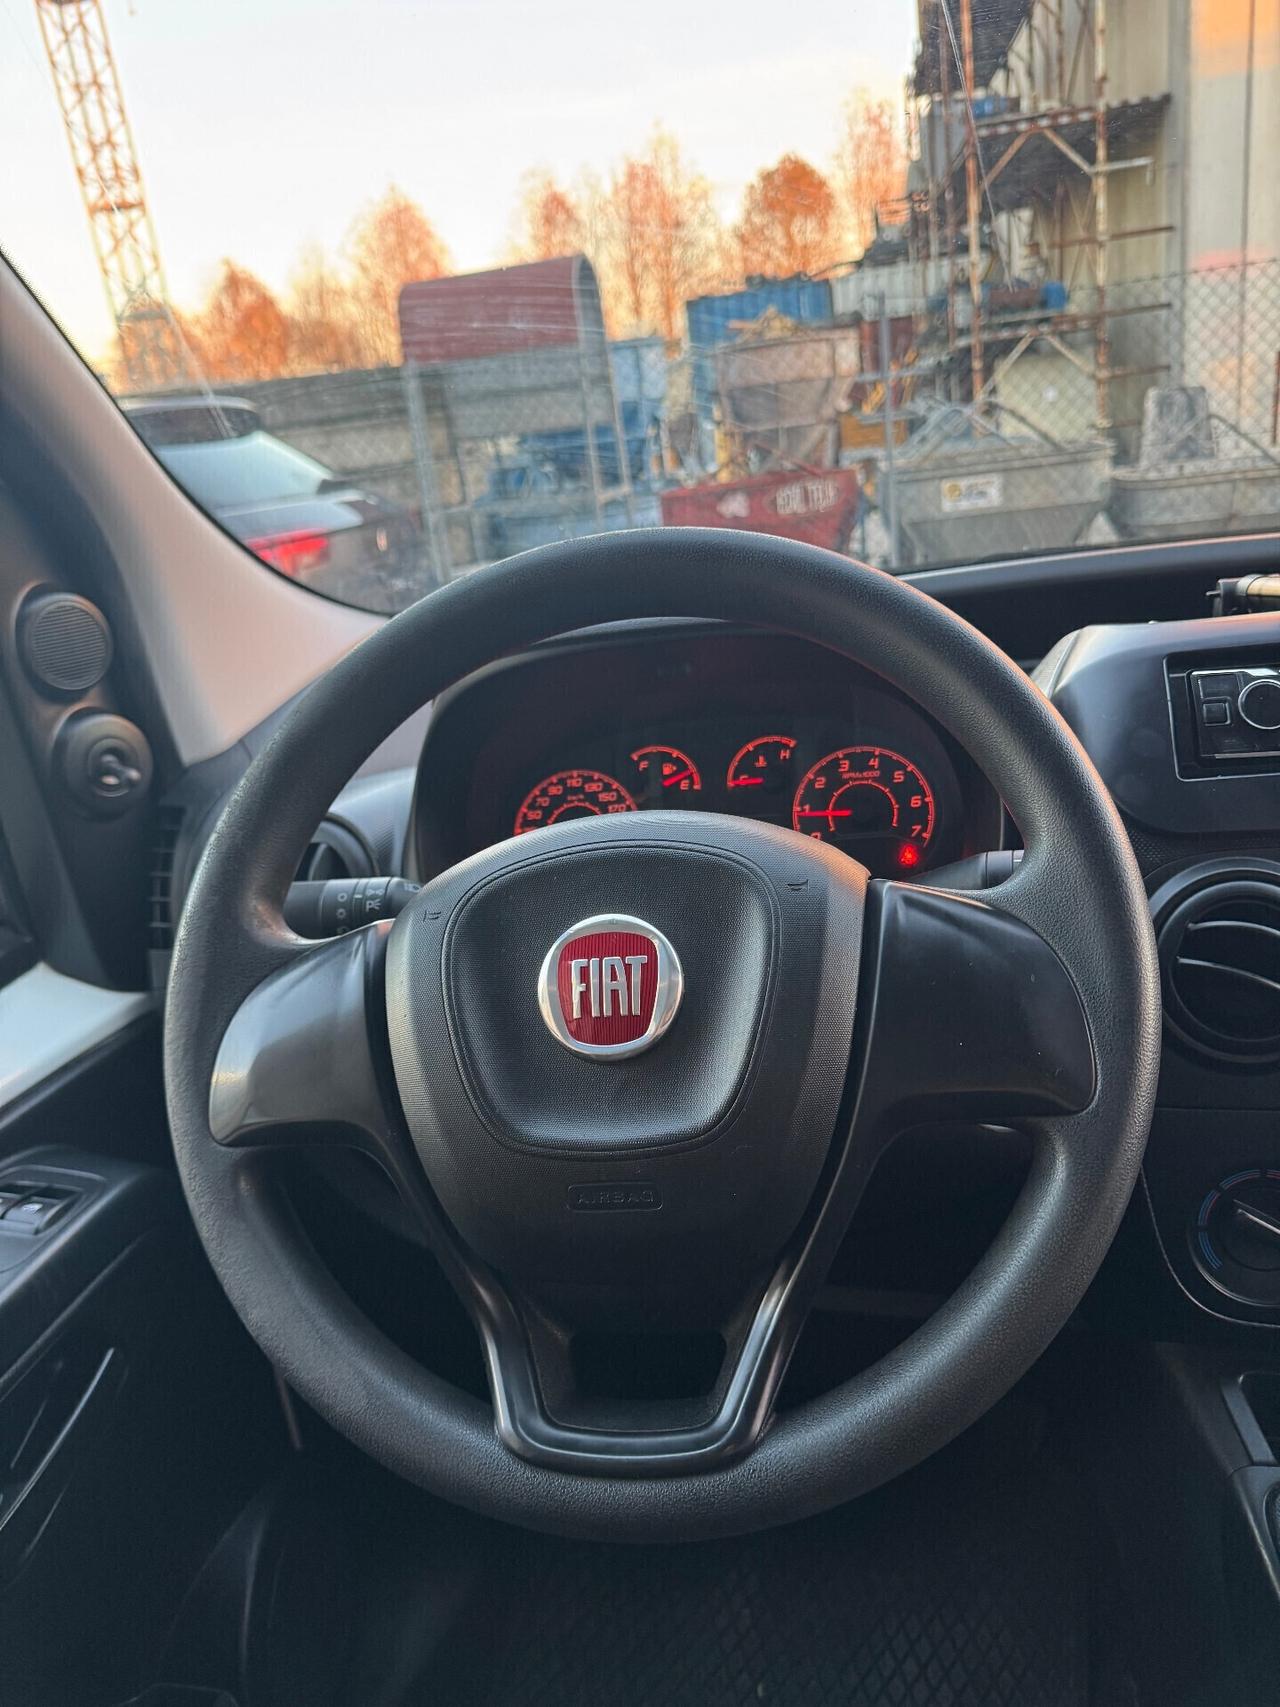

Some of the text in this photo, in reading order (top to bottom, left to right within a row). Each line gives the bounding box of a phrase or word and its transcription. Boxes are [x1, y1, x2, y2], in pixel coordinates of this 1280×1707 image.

[779, 749, 790, 760] H
[639, 760, 649, 771] F
[838, 759, 850, 772] 3
[868, 757, 880, 769] 4
[814, 776, 827, 788] 2
[892, 771, 905, 783] 5
[680, 779, 690, 791] E
[910, 795, 922, 808] 6
[911, 825, 922, 837] 7
[571, 955, 648, 1019] FIAT
